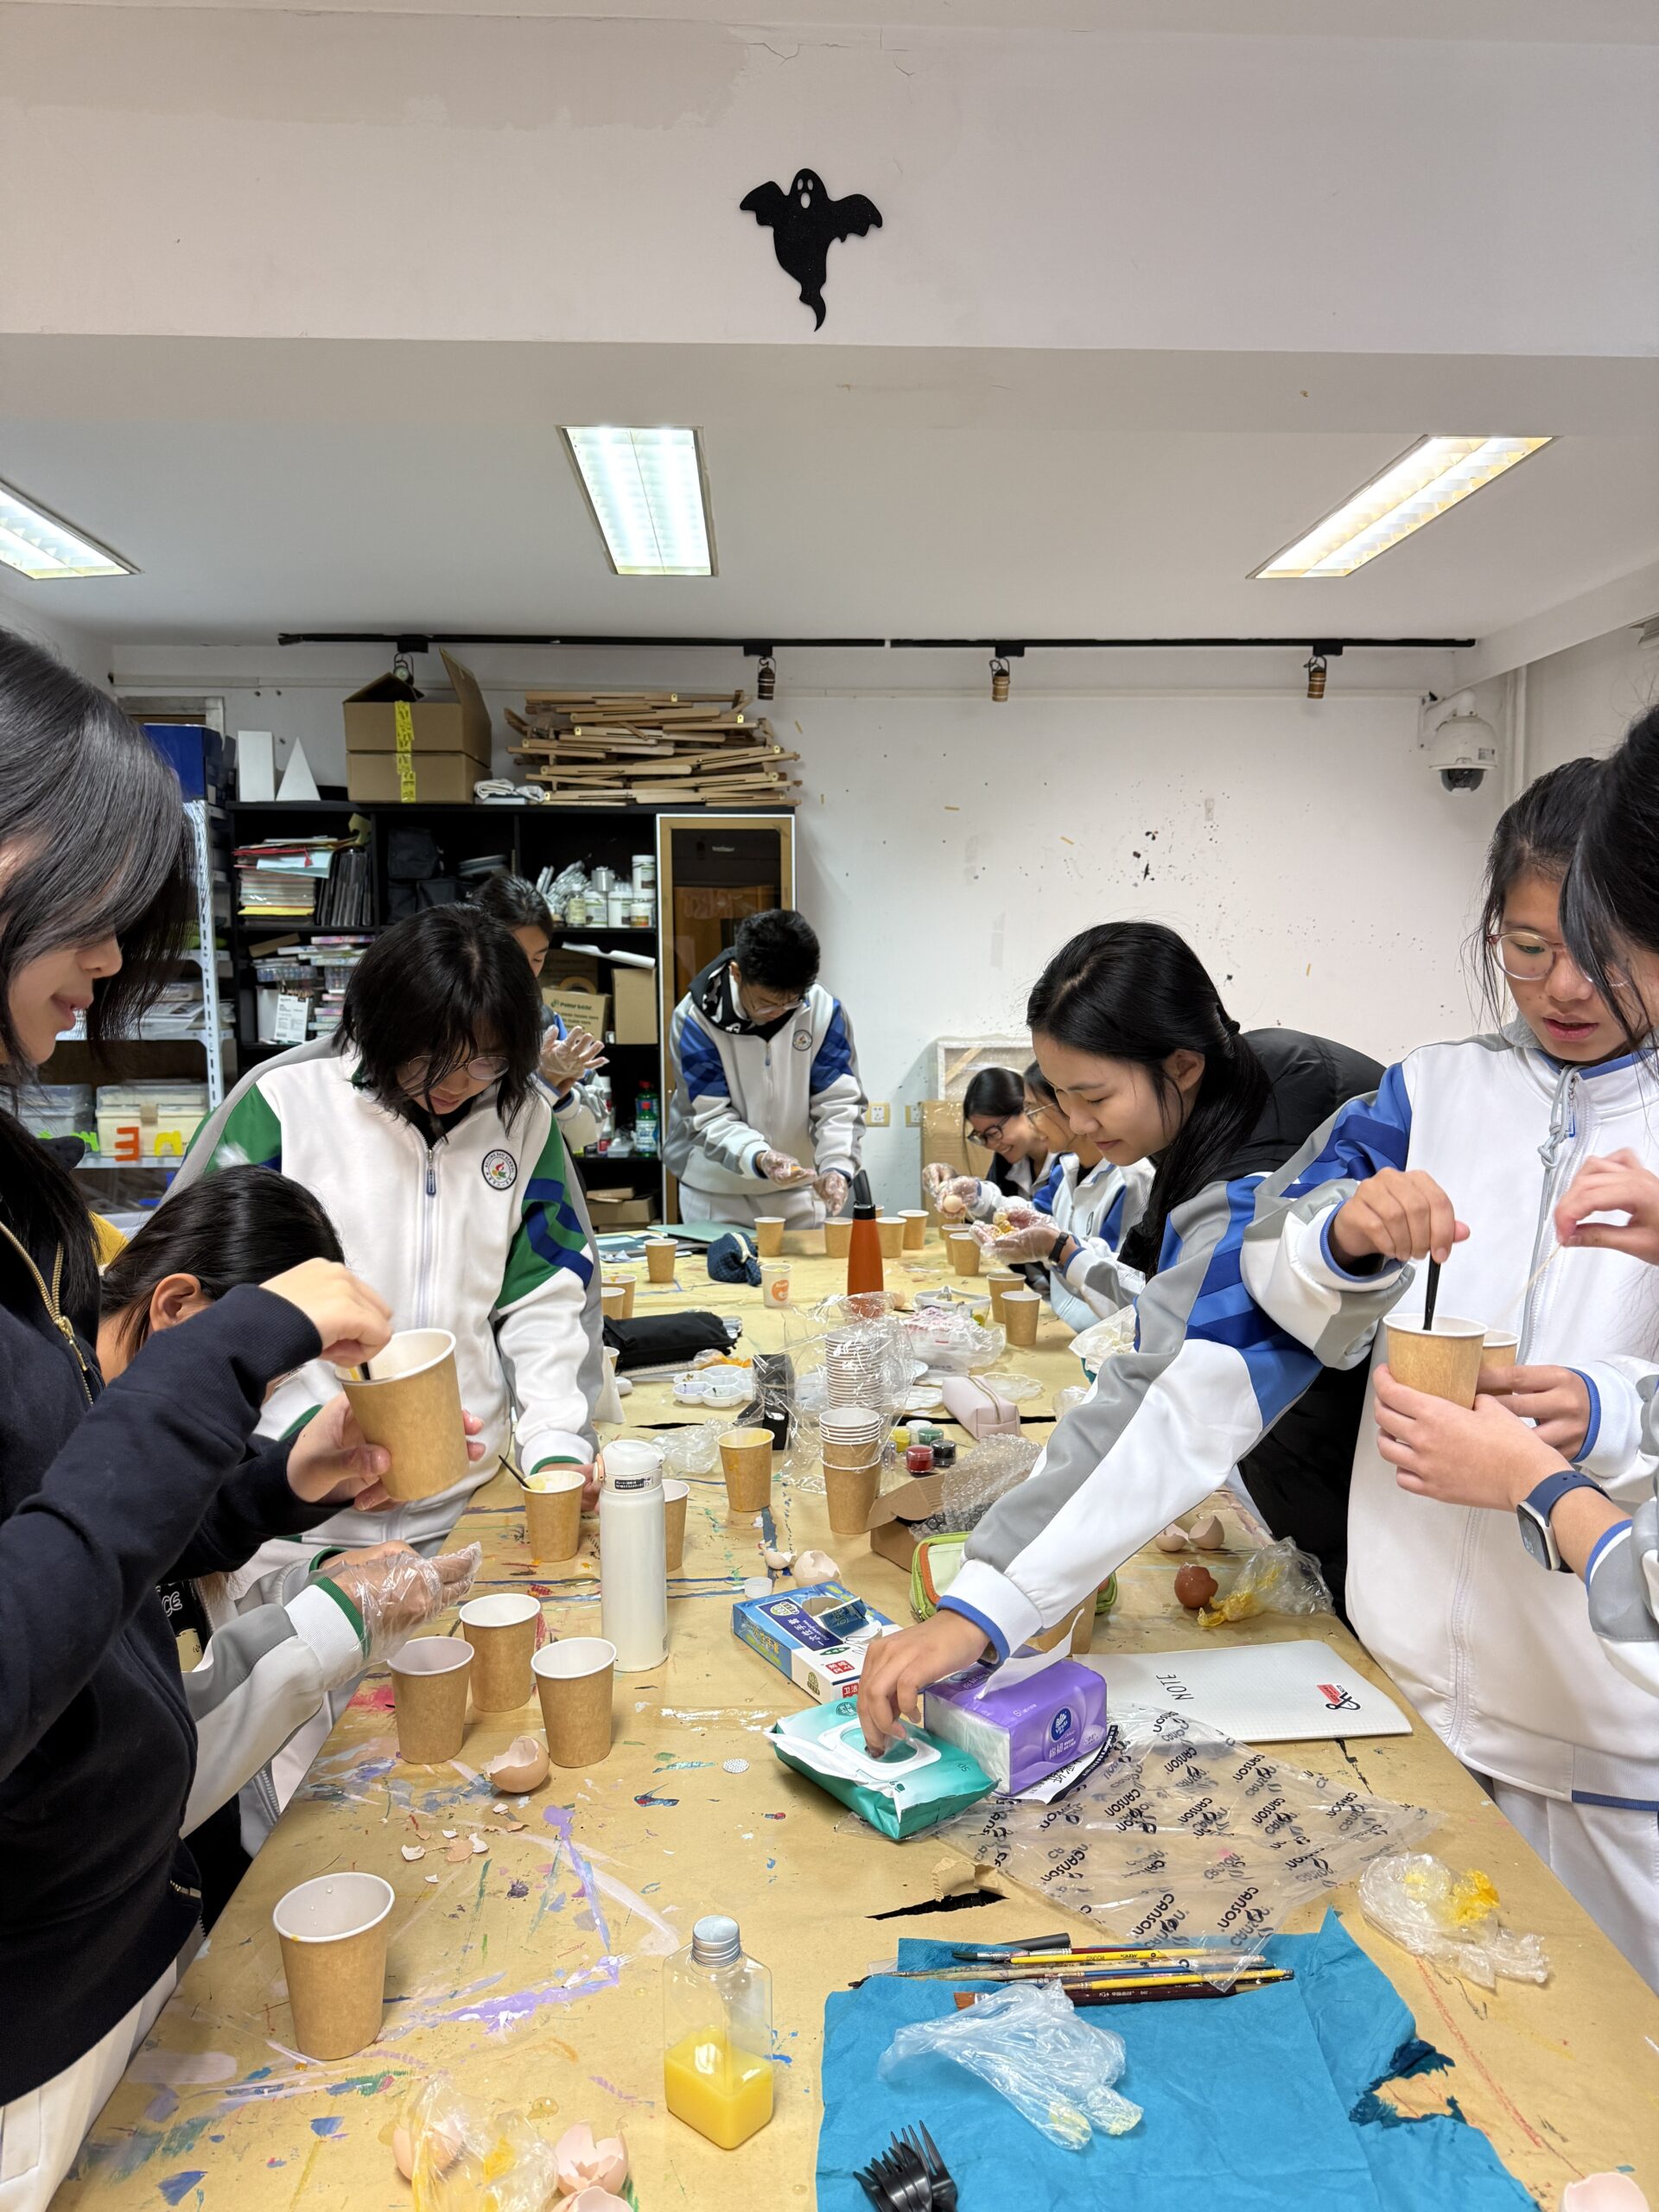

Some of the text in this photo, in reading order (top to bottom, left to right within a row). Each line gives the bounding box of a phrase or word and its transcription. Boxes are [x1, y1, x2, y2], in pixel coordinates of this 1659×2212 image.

[1156, 1673, 1195, 1700] NOTE
[1166, 1747, 1198, 1773] CANSON
[1105, 1789, 1141, 1816] CANSON
[1178, 1797, 1213, 1823] CANSON
[1252, 1797, 1286, 1825] CANSON
[1041, 1850, 1086, 1883] CANSON
[1132, 1893, 1175, 1936] CANSON
[1217, 1886, 1259, 1929] CANSON
